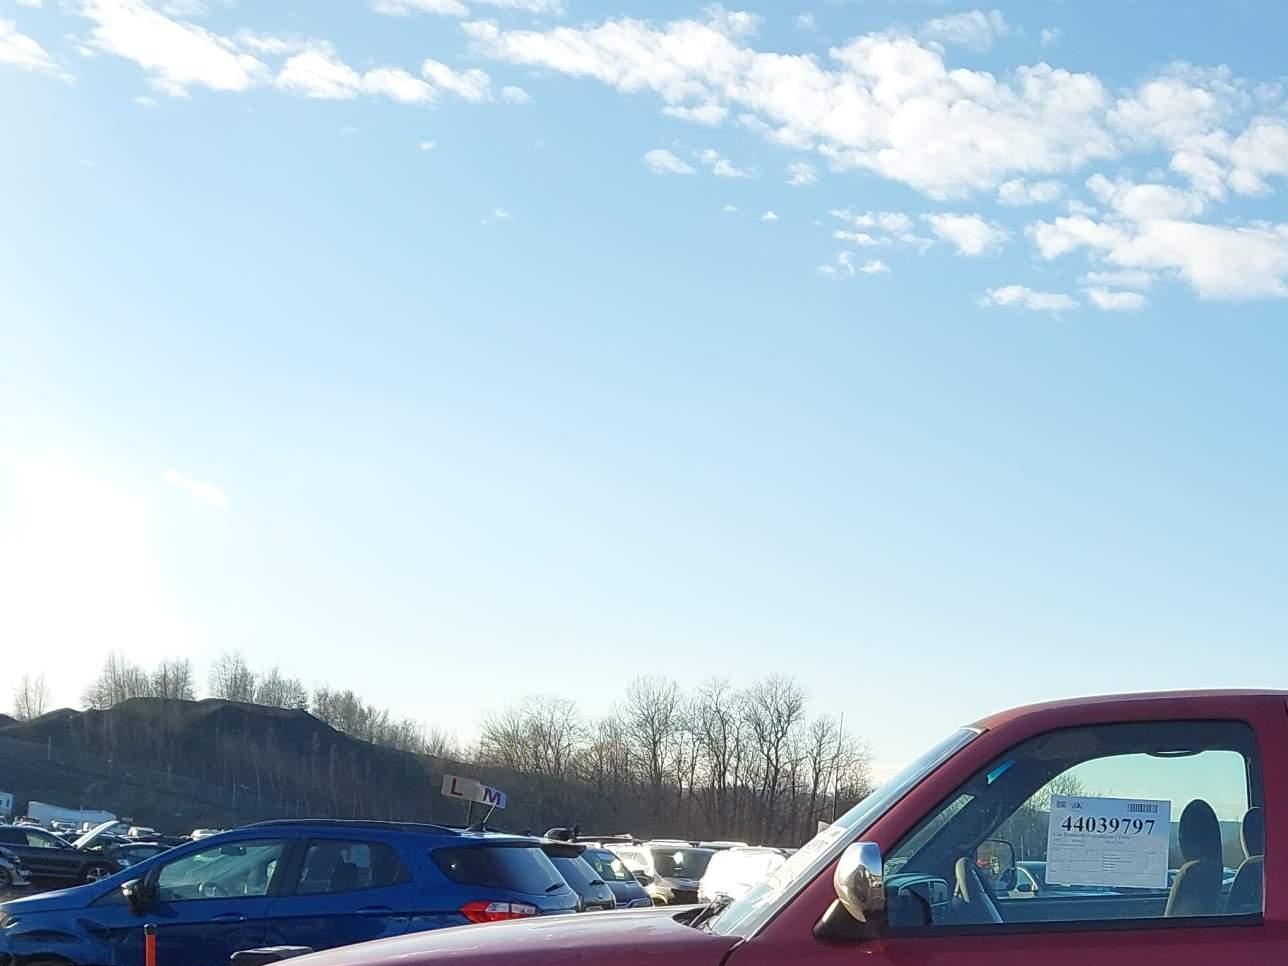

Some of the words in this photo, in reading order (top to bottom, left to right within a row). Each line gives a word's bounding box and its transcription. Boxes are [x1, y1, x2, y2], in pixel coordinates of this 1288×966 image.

[450, 777, 463, 797] L
[482, 787, 502, 806] M
[1061, 815, 1156, 836] 44039797
